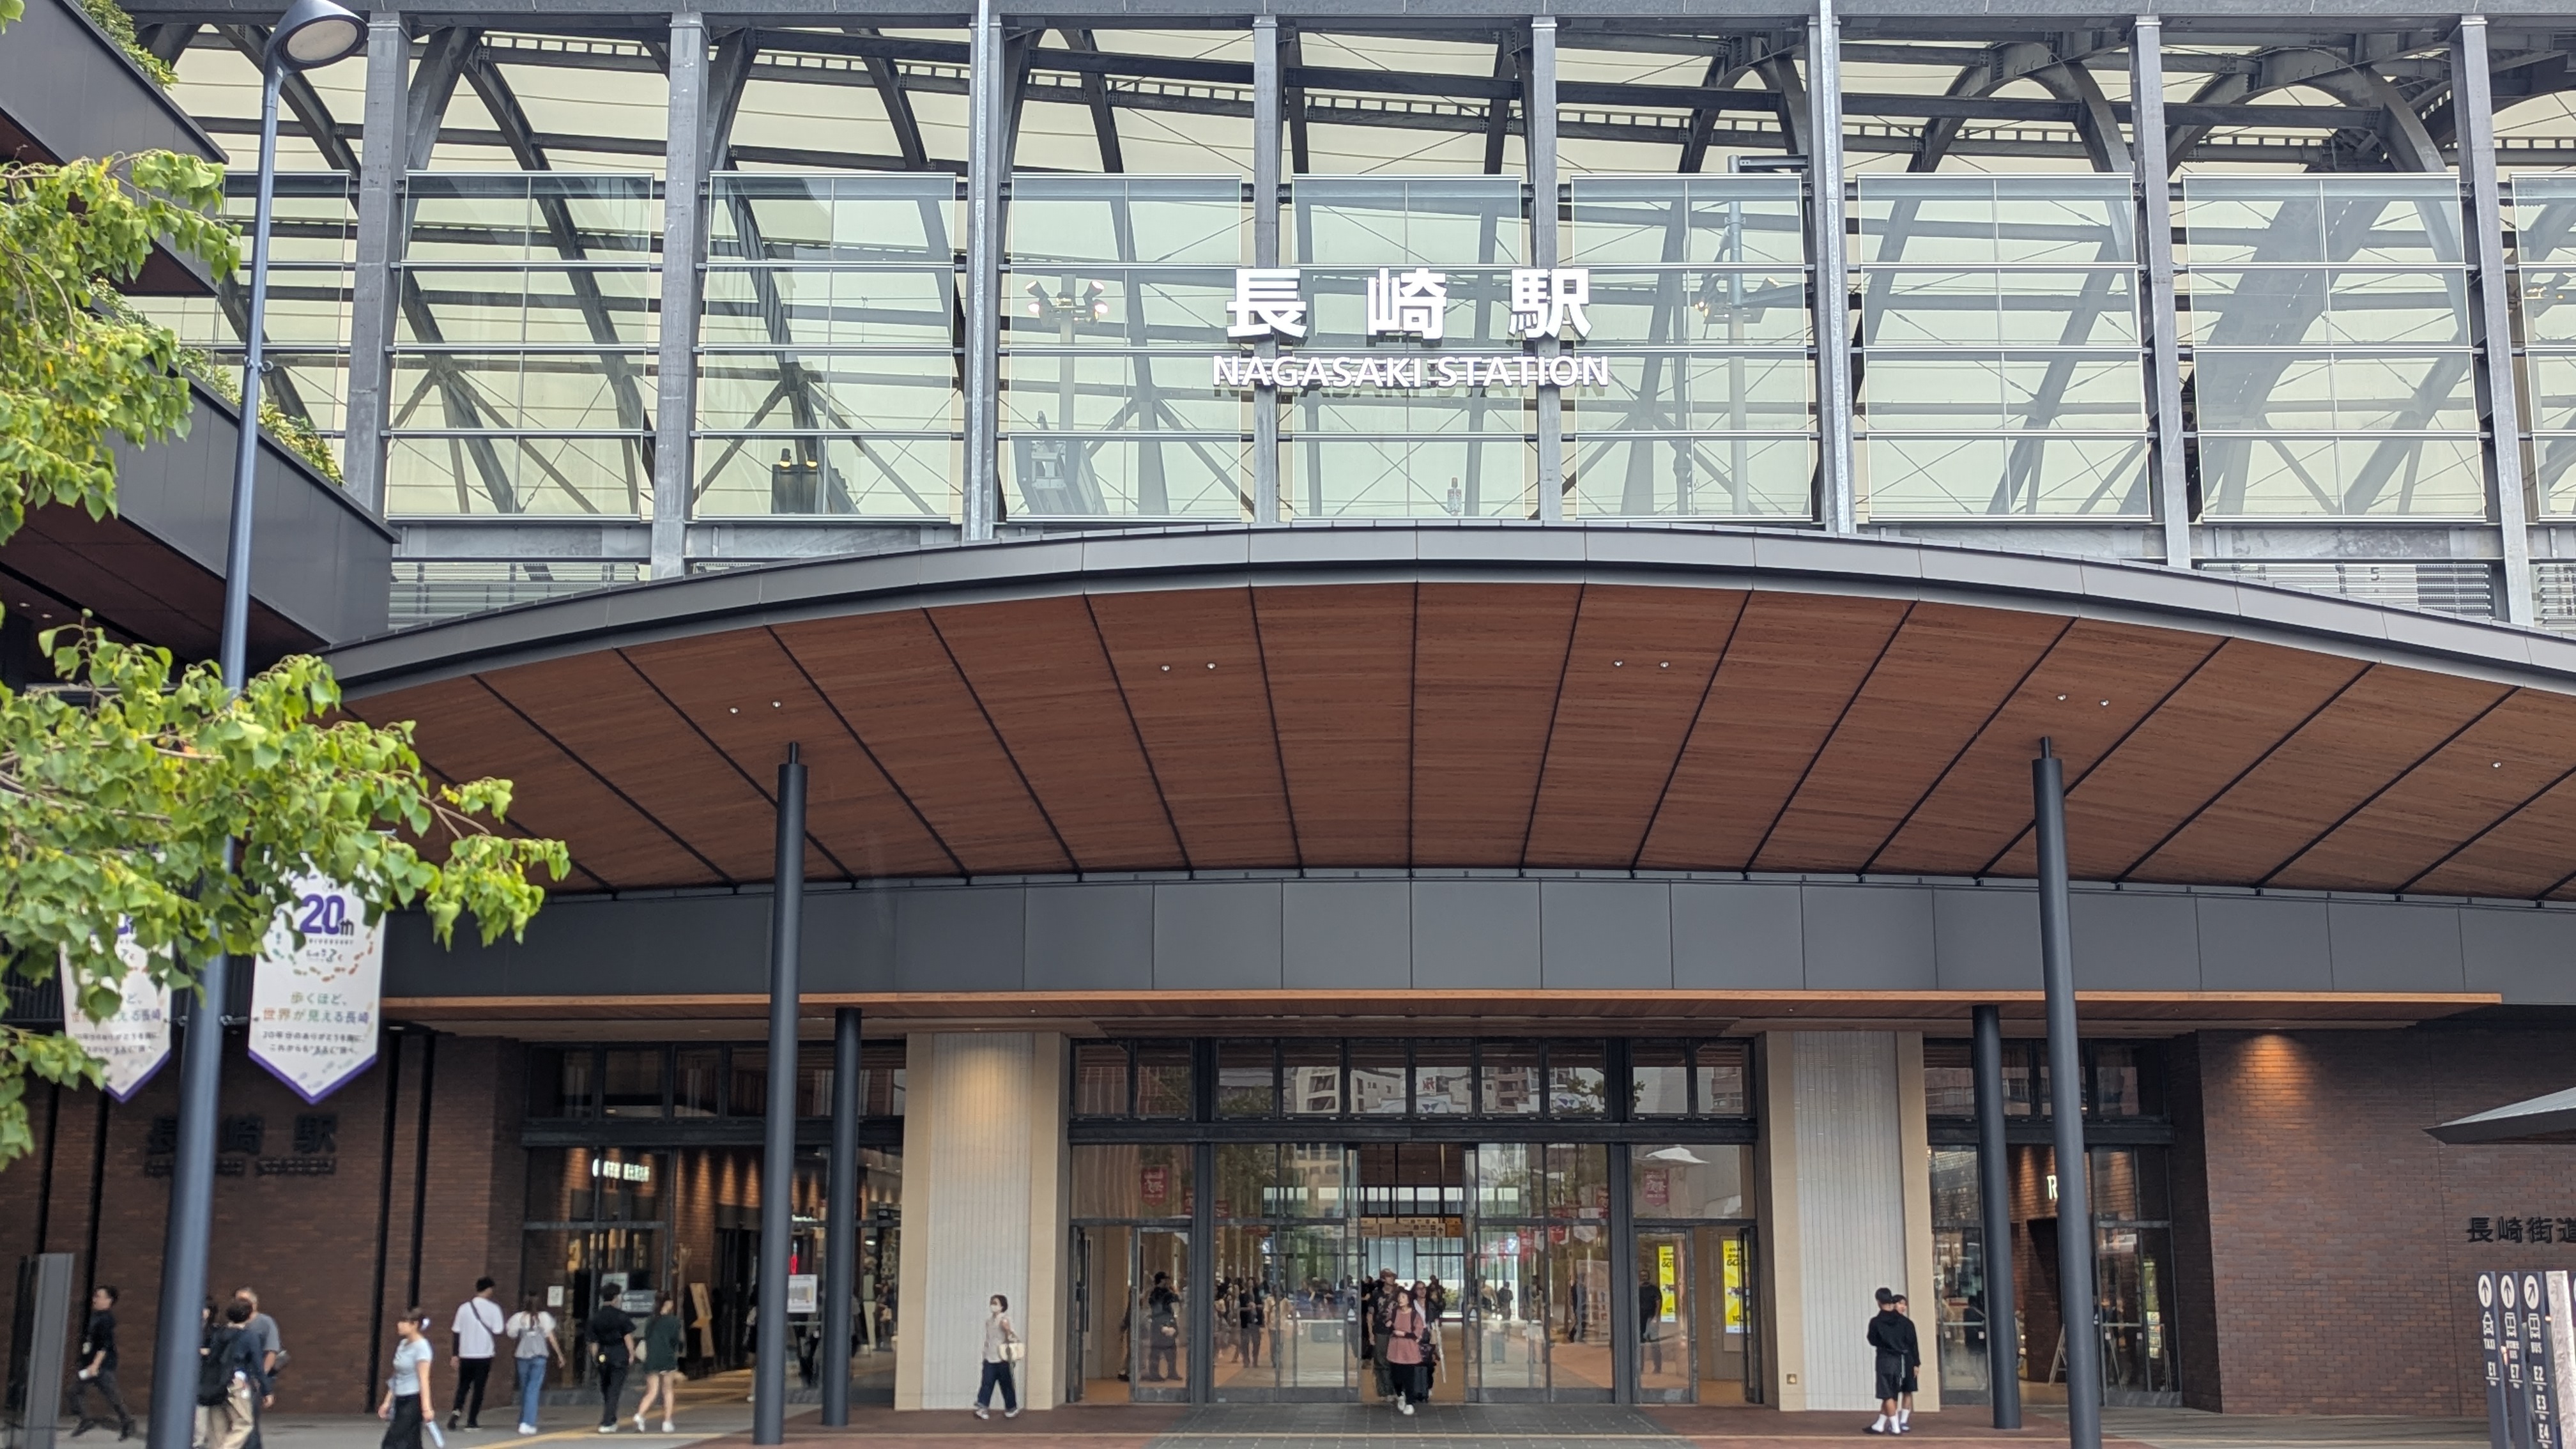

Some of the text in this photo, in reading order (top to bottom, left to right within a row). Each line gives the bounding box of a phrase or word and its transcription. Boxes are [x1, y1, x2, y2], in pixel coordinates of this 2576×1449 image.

[1226, 267, 1592, 339] 長崎駅
[1213, 355, 1609, 388] NAGASAKI STATION
[263, 1008, 369, 1023] 世界が見える長崎
[2466, 1216, 2576, 1243] 長崎街道
[2533, 1365, 2544, 1381] E2
[2538, 1423, 2549, 1439] E4
